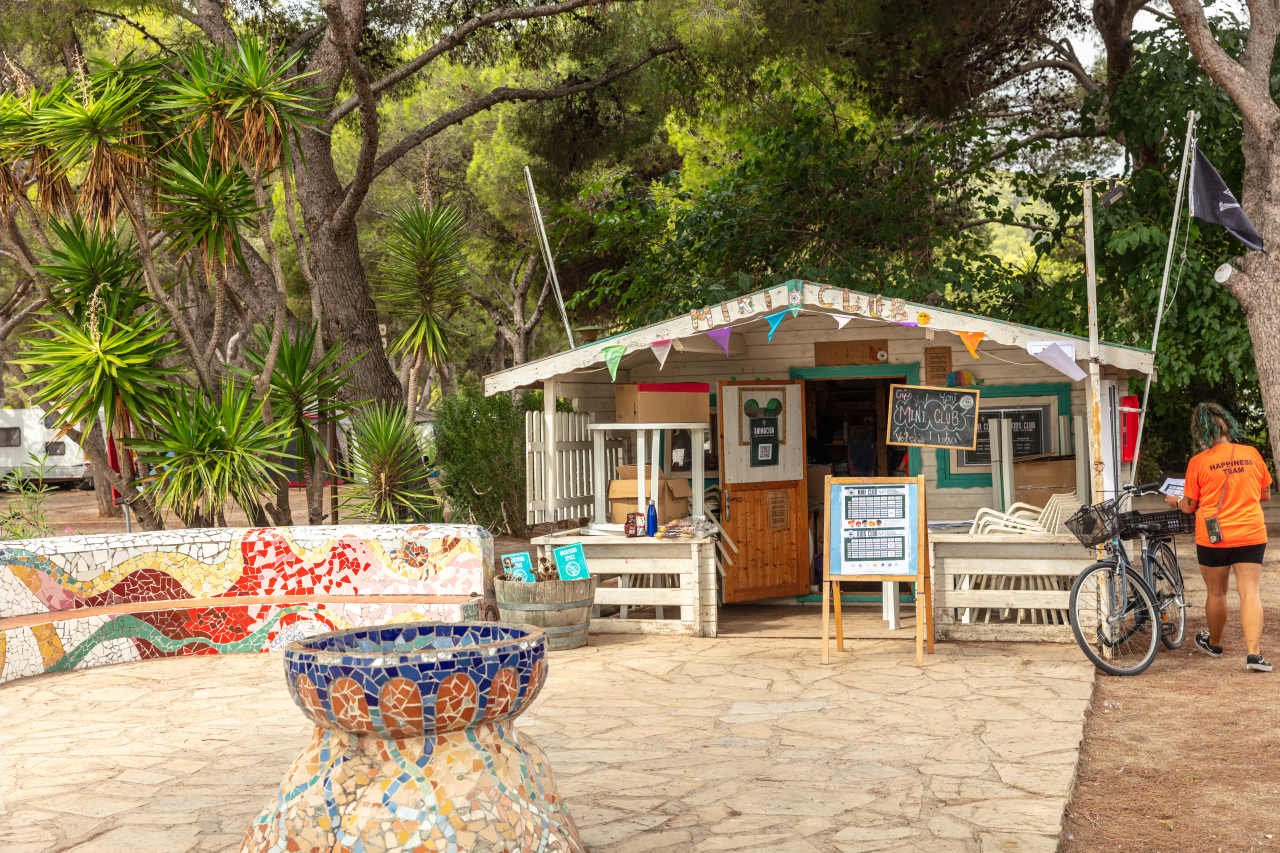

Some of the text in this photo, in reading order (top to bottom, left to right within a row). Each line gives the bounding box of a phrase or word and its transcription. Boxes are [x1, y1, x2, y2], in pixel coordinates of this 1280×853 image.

[690, 285, 909, 330] MINI CLUB
[933, 408, 959, 426] CLUB
[1209, 459, 1253, 471] HAPPINESS
[1223, 467, 1245, 475] TEAM
